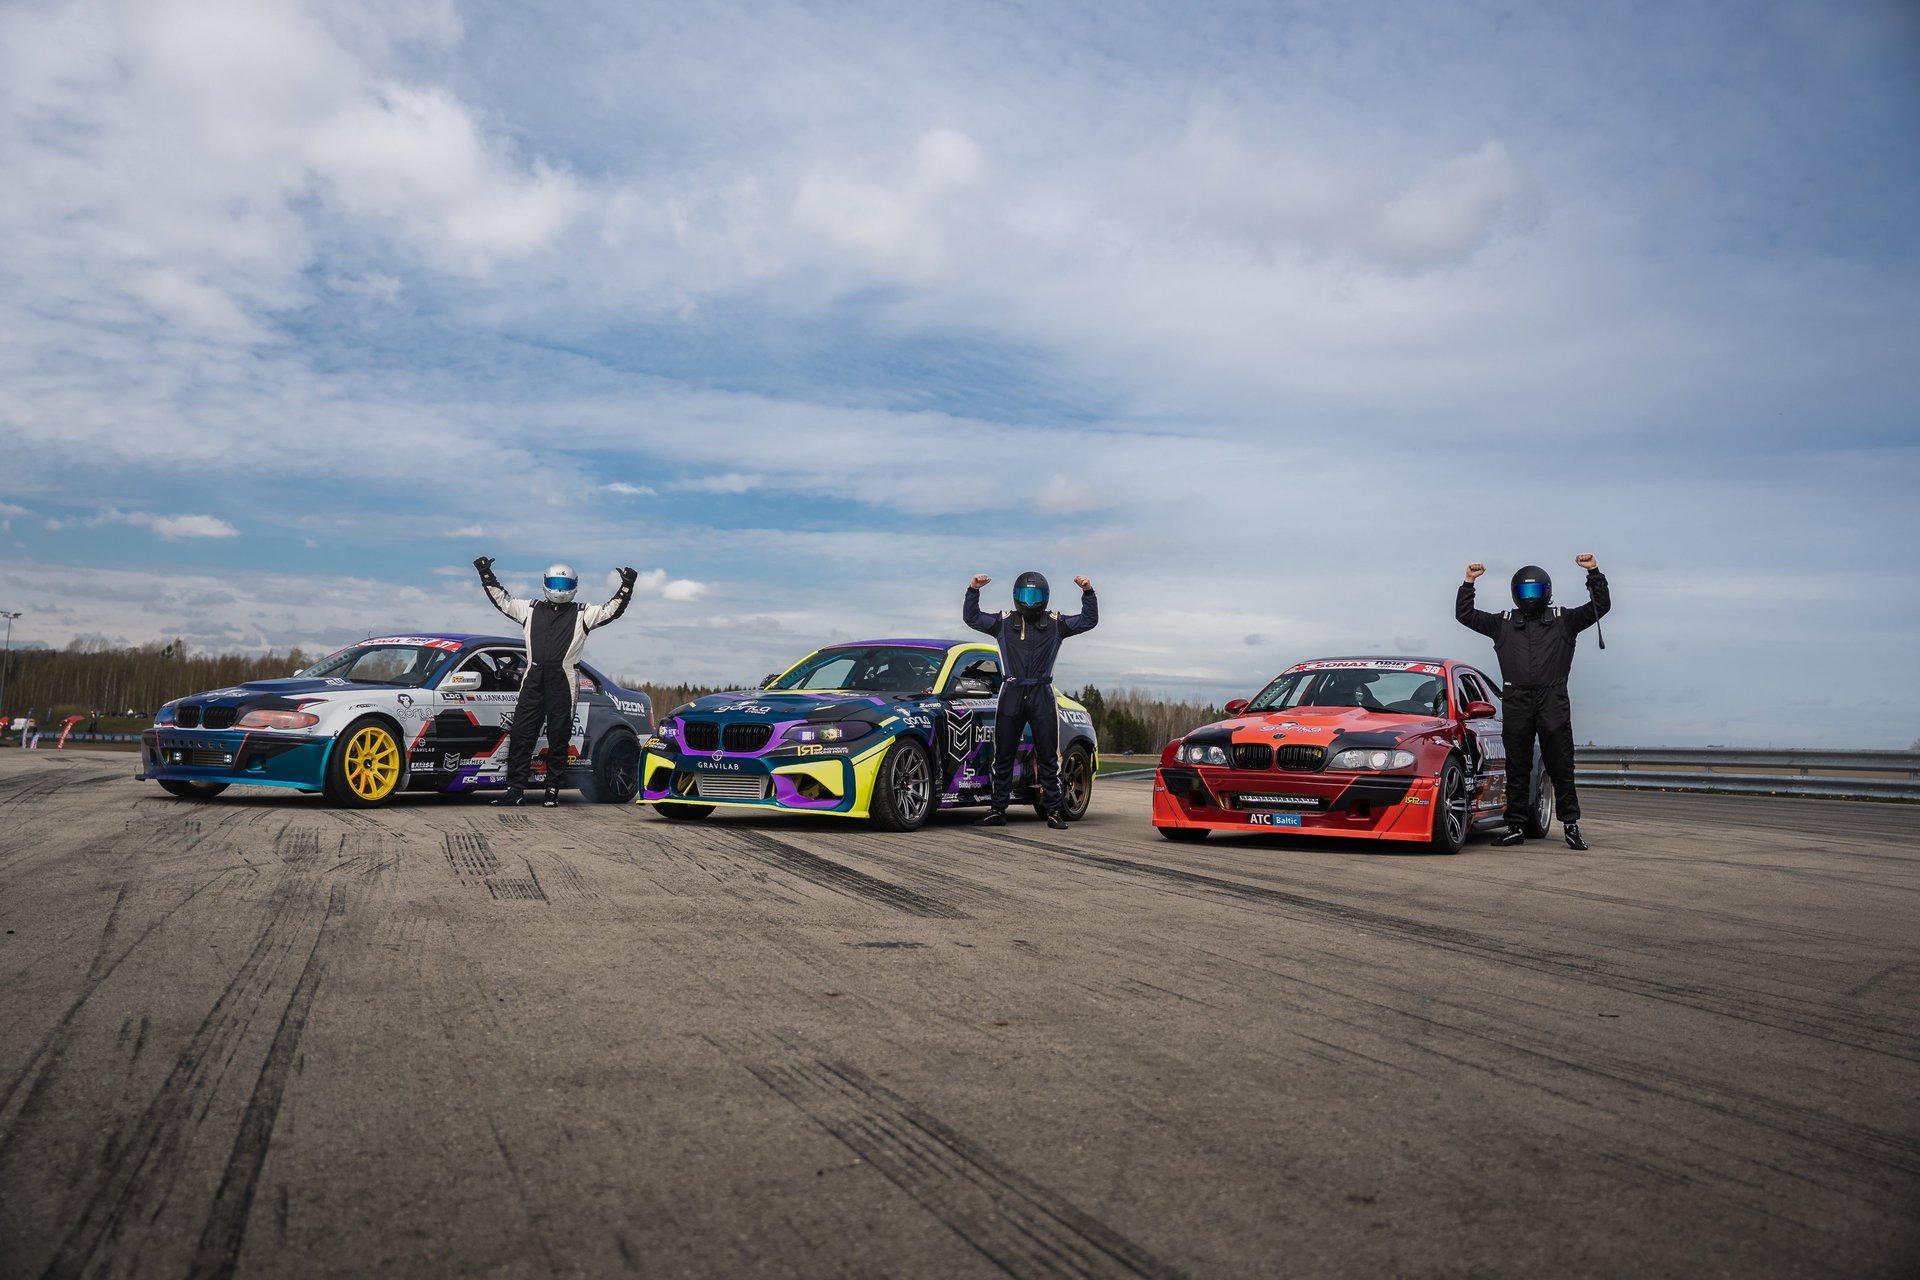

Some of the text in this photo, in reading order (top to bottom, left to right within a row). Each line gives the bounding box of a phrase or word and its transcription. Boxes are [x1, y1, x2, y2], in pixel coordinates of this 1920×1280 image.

[1314, 661, 1368, 669] SONAX
[1422, 665, 1441, 674] 38
[612, 696, 645, 713] VIZON
[697, 761, 740, 771] GRAVILAB
[1250, 813, 1298, 825] ATC Baltic
